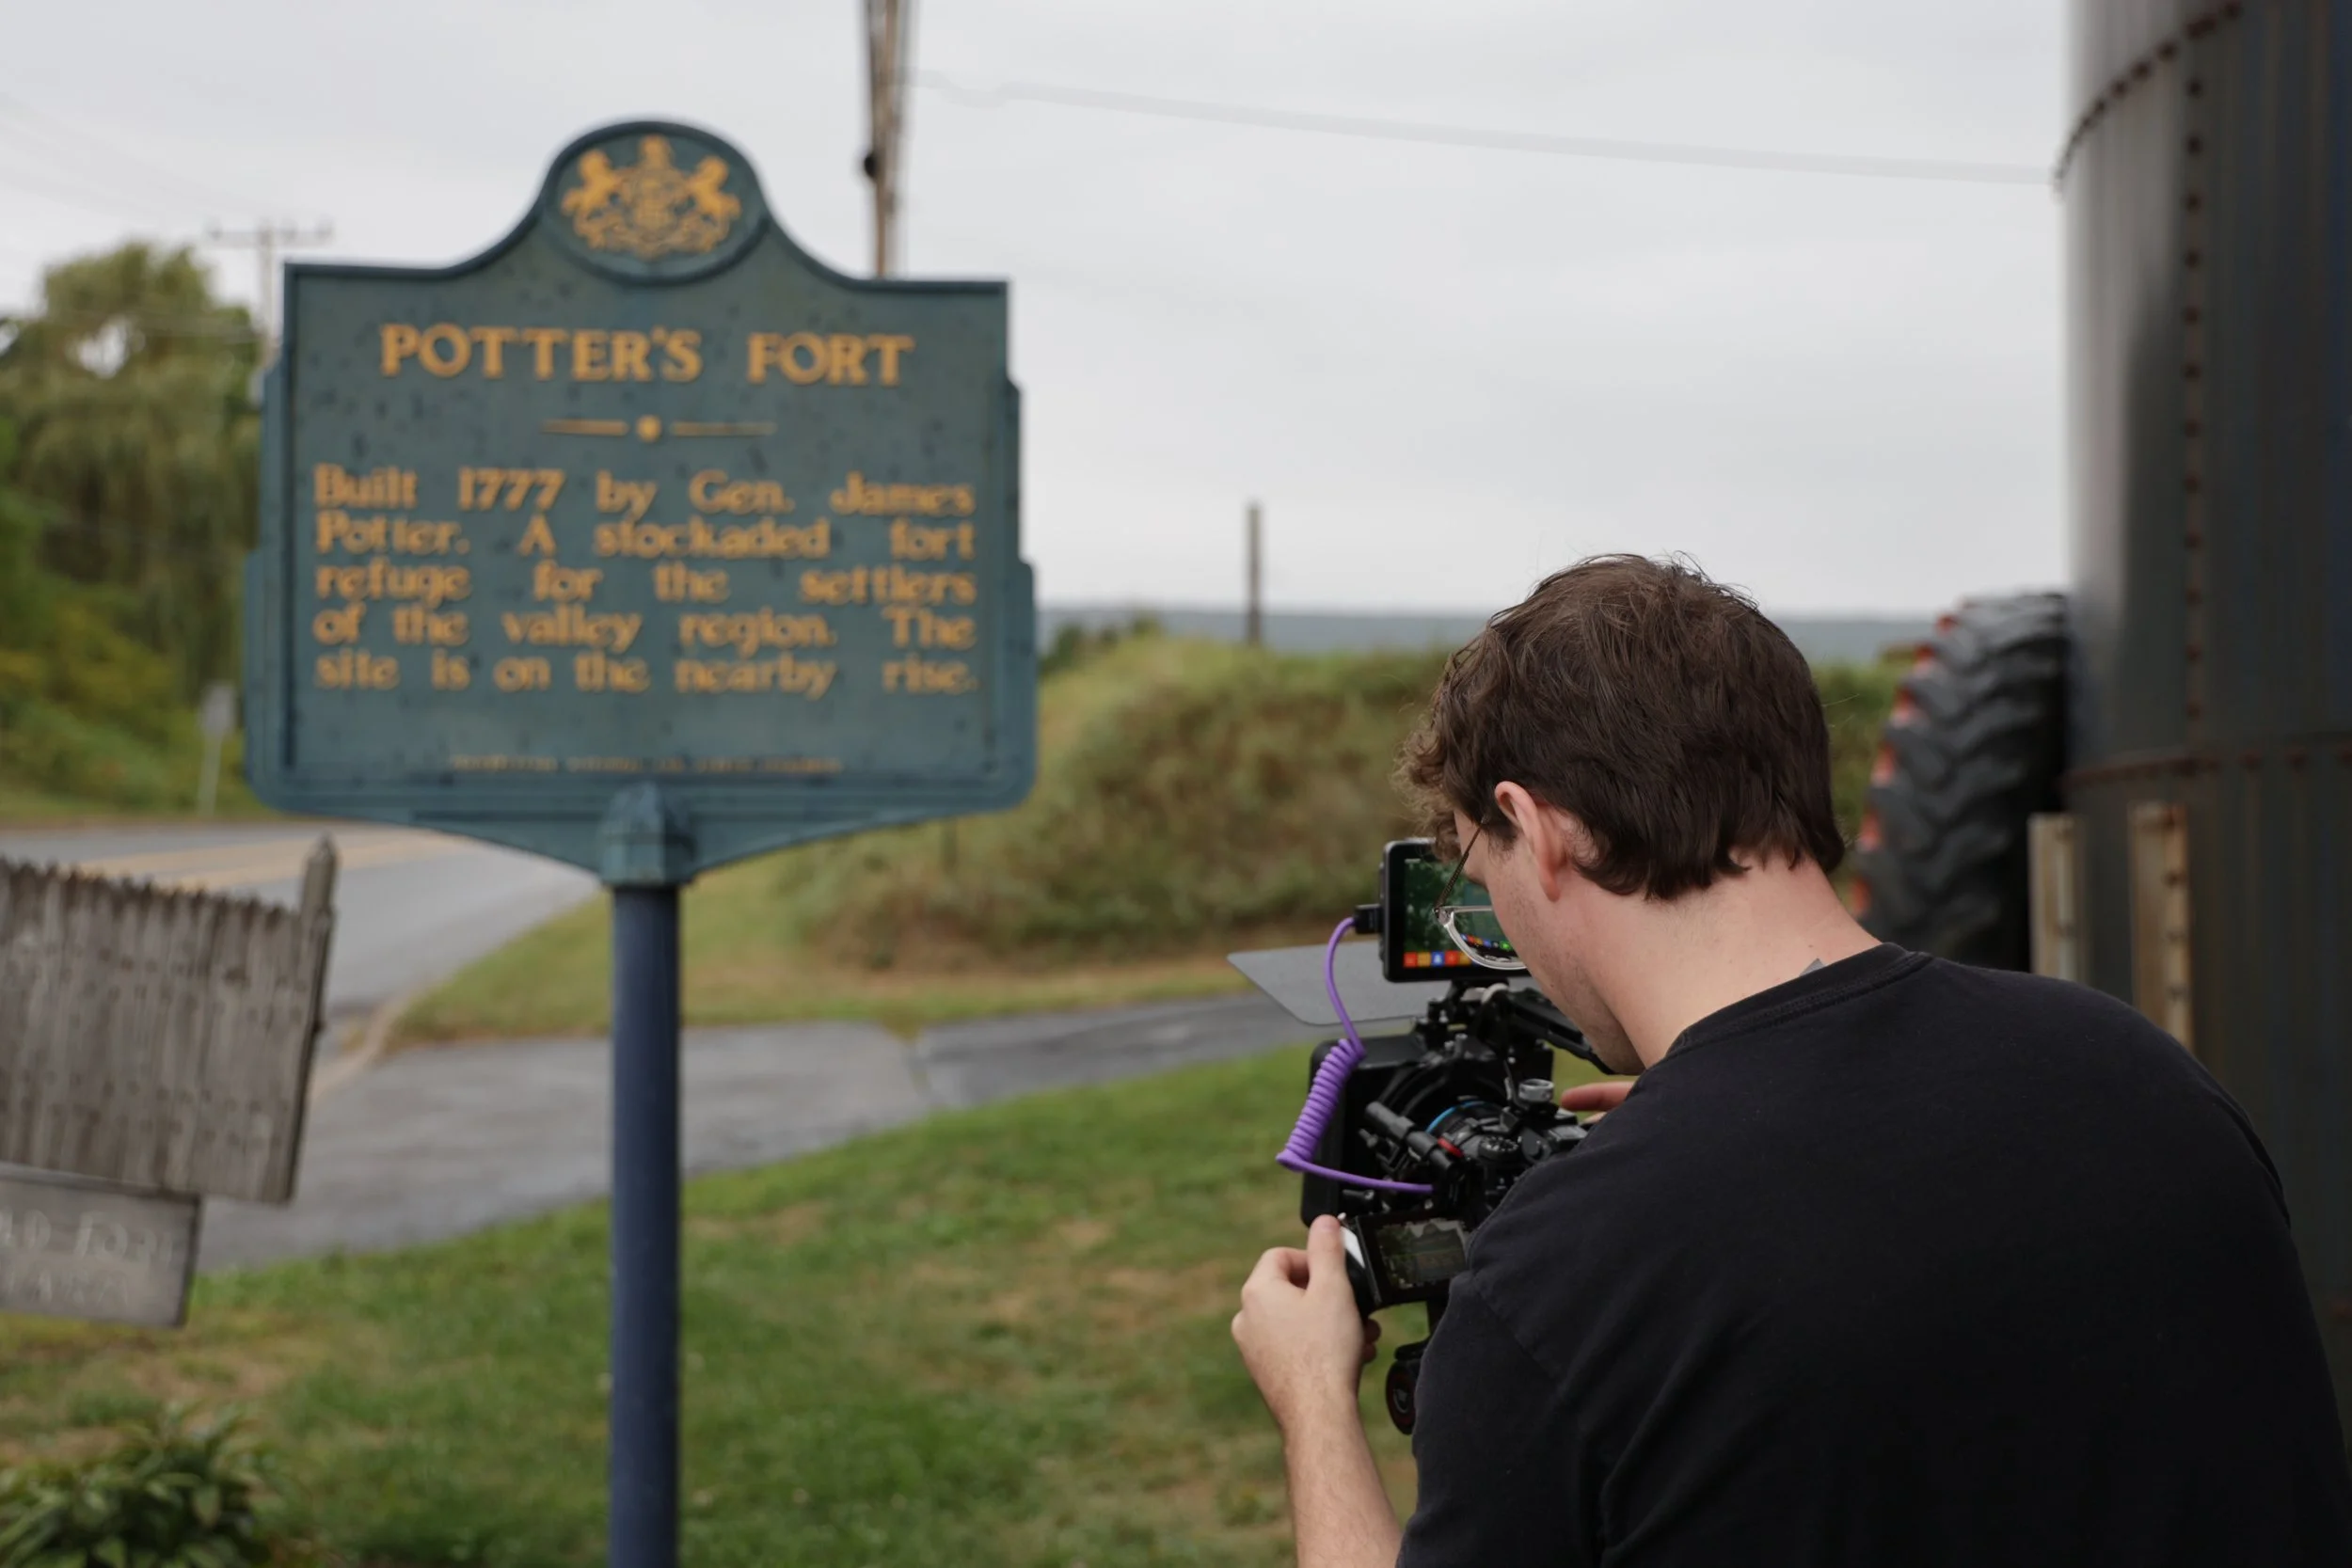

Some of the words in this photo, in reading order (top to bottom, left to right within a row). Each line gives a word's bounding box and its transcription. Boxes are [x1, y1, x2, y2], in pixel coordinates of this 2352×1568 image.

[380, 323, 703, 382] POTTER'S
[747, 331, 915, 387] FORT
[313, 462, 419, 512] Built
[458, 467, 565, 513] 1777
[596, 469, 657, 518] by
[689, 470, 794, 515] Gen.
[830, 470, 976, 516] James
[316, 510, 469, 554] Potter.
[518, 514, 557, 559] A
[595, 515, 831, 559] stockaded
[889, 519, 976, 561] fort
[316, 559, 470, 610] refuge
[533, 560, 602, 605] for
[654, 562, 728, 602] the
[801, 564, 977, 605] settlers
[312, 604, 366, 644] of
[392, 606, 468, 645] the
[502, 609, 642, 655] valley
[679, 611, 835, 657] region.
[883, 605, 976, 649] The
[314, 650, 398, 689] site
[432, 650, 470, 689] is
[494, 657, 551, 691] on
[574, 650, 650, 692] the
[675, 650, 836, 699] nearby
[882, 654, 979, 693] rise.
